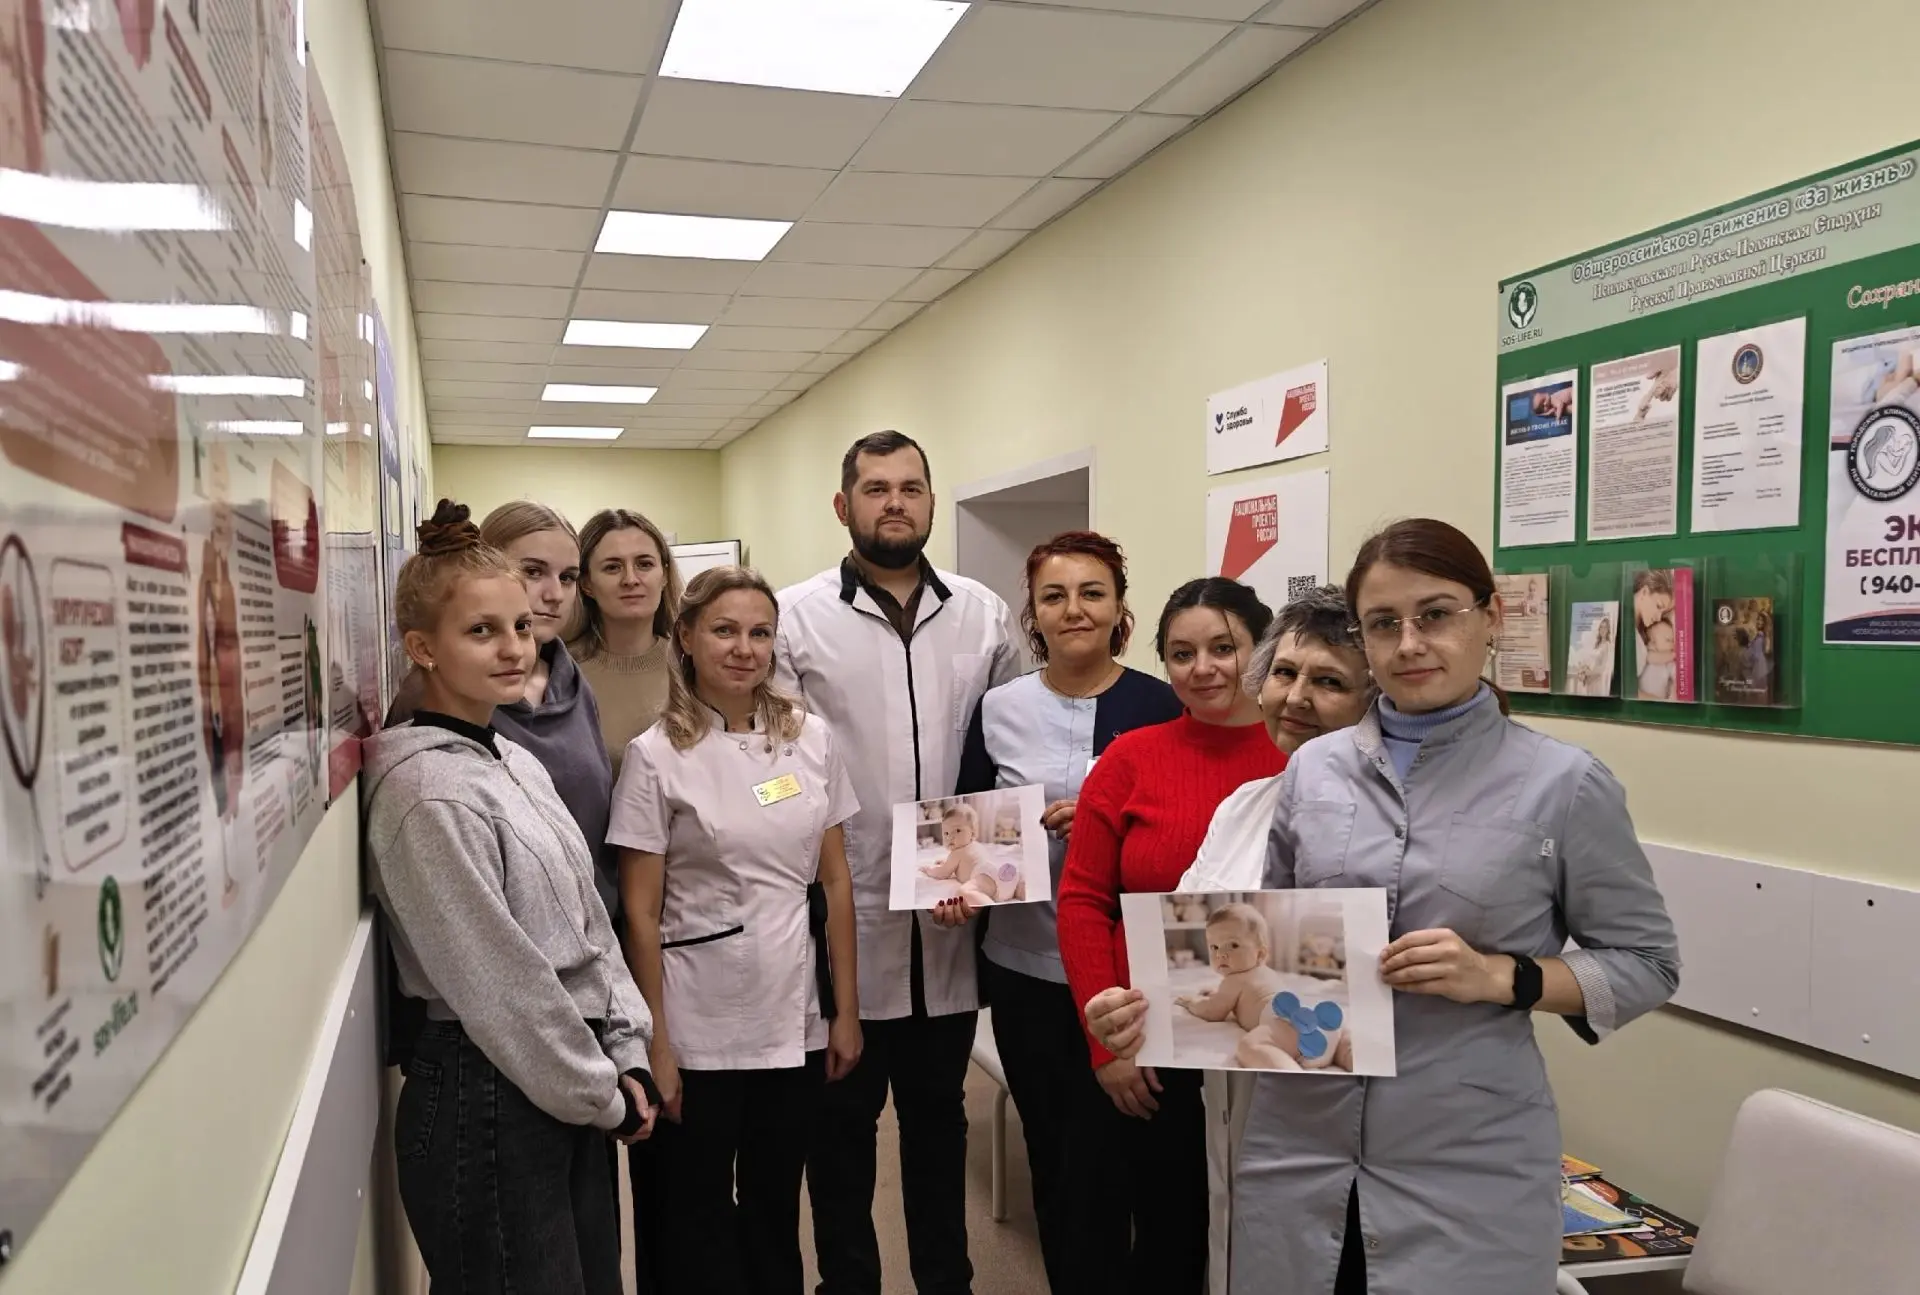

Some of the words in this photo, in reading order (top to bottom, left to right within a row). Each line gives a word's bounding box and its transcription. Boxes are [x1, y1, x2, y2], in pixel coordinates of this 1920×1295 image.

[1573, 230, 1699, 283] Общероссийское
[1701, 200, 1790, 246] движение
[1794, 186, 1828, 210] «За
[1832, 160, 1914, 201] жизнь»
[1630, 286, 1675, 313] Русской
[1677, 259, 1767, 301] Православной
[1502, 329, 1543, 346] SOS-LIFE.RU
[1226, 406, 1248, 420] Служба
[1226, 416, 1253, 430] здоровья
[1234, 496, 1277, 516] НАЦИОНАЛЬНЫЕ
[1252, 512, 1277, 528] ПРОЕКТЫ
[1256, 527, 1277, 542] РОССИИ
[1846, 546, 1920, 567] БЕСПЛ
